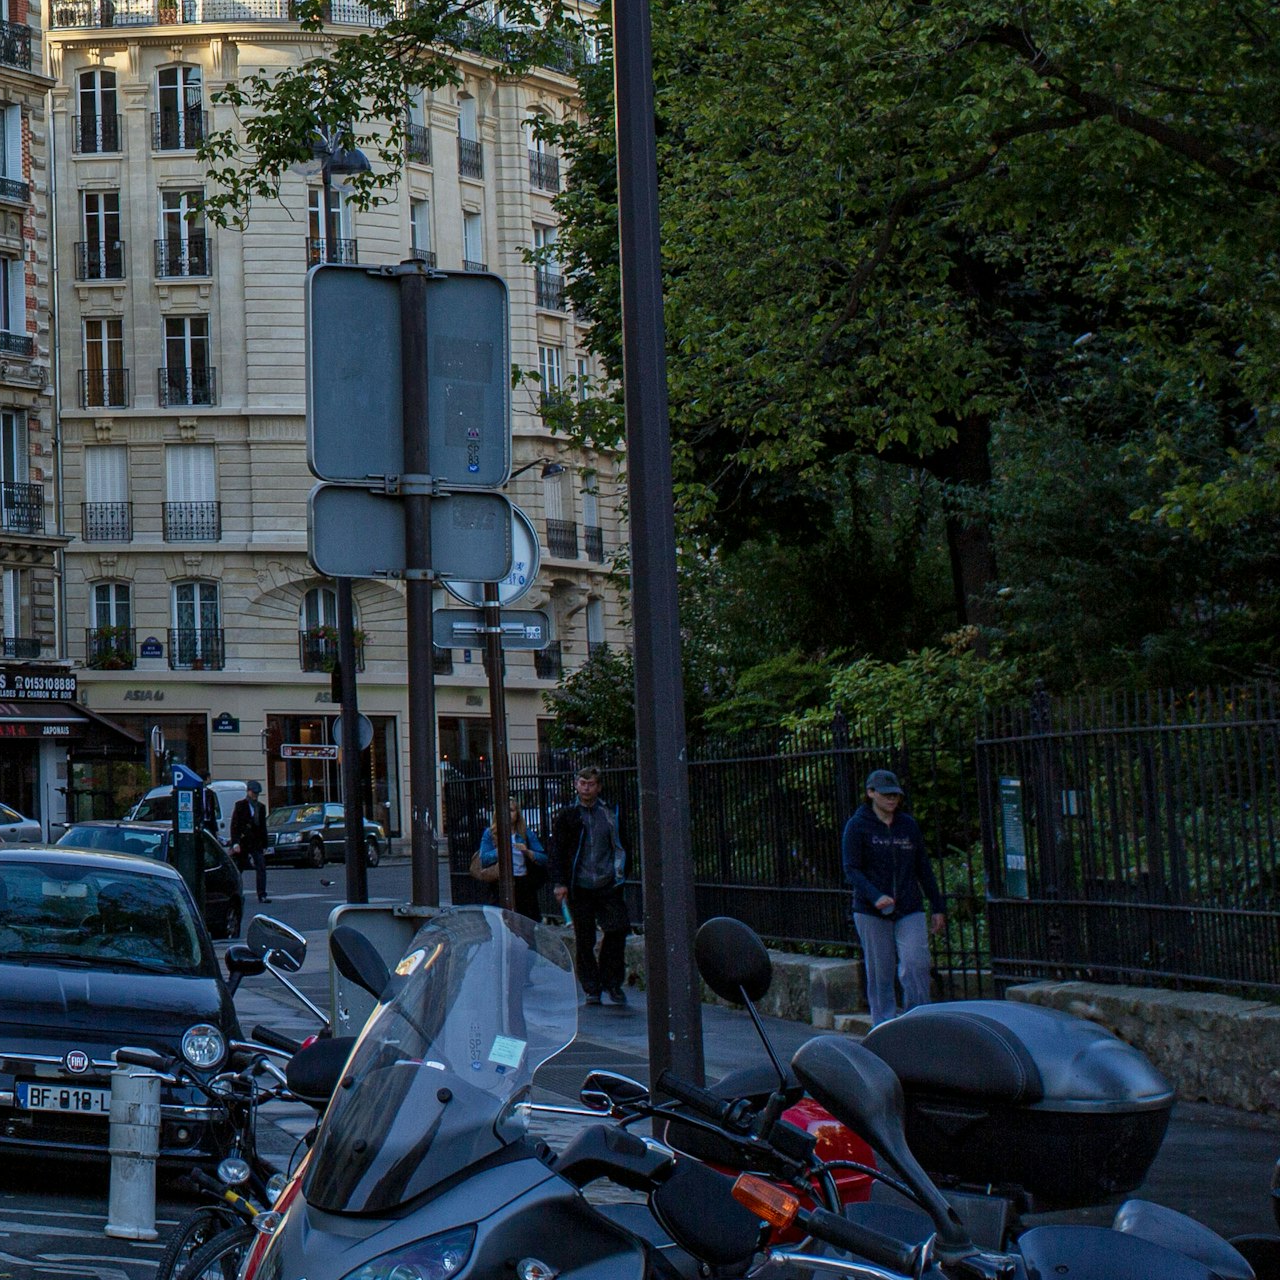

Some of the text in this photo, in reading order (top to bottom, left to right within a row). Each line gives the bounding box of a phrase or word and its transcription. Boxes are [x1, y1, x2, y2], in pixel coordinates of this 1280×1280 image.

[42, 726, 70, 736] JAPONAIS
[173, 771, 184, 787] P
[71, 1056, 85, 1067] FIAT
